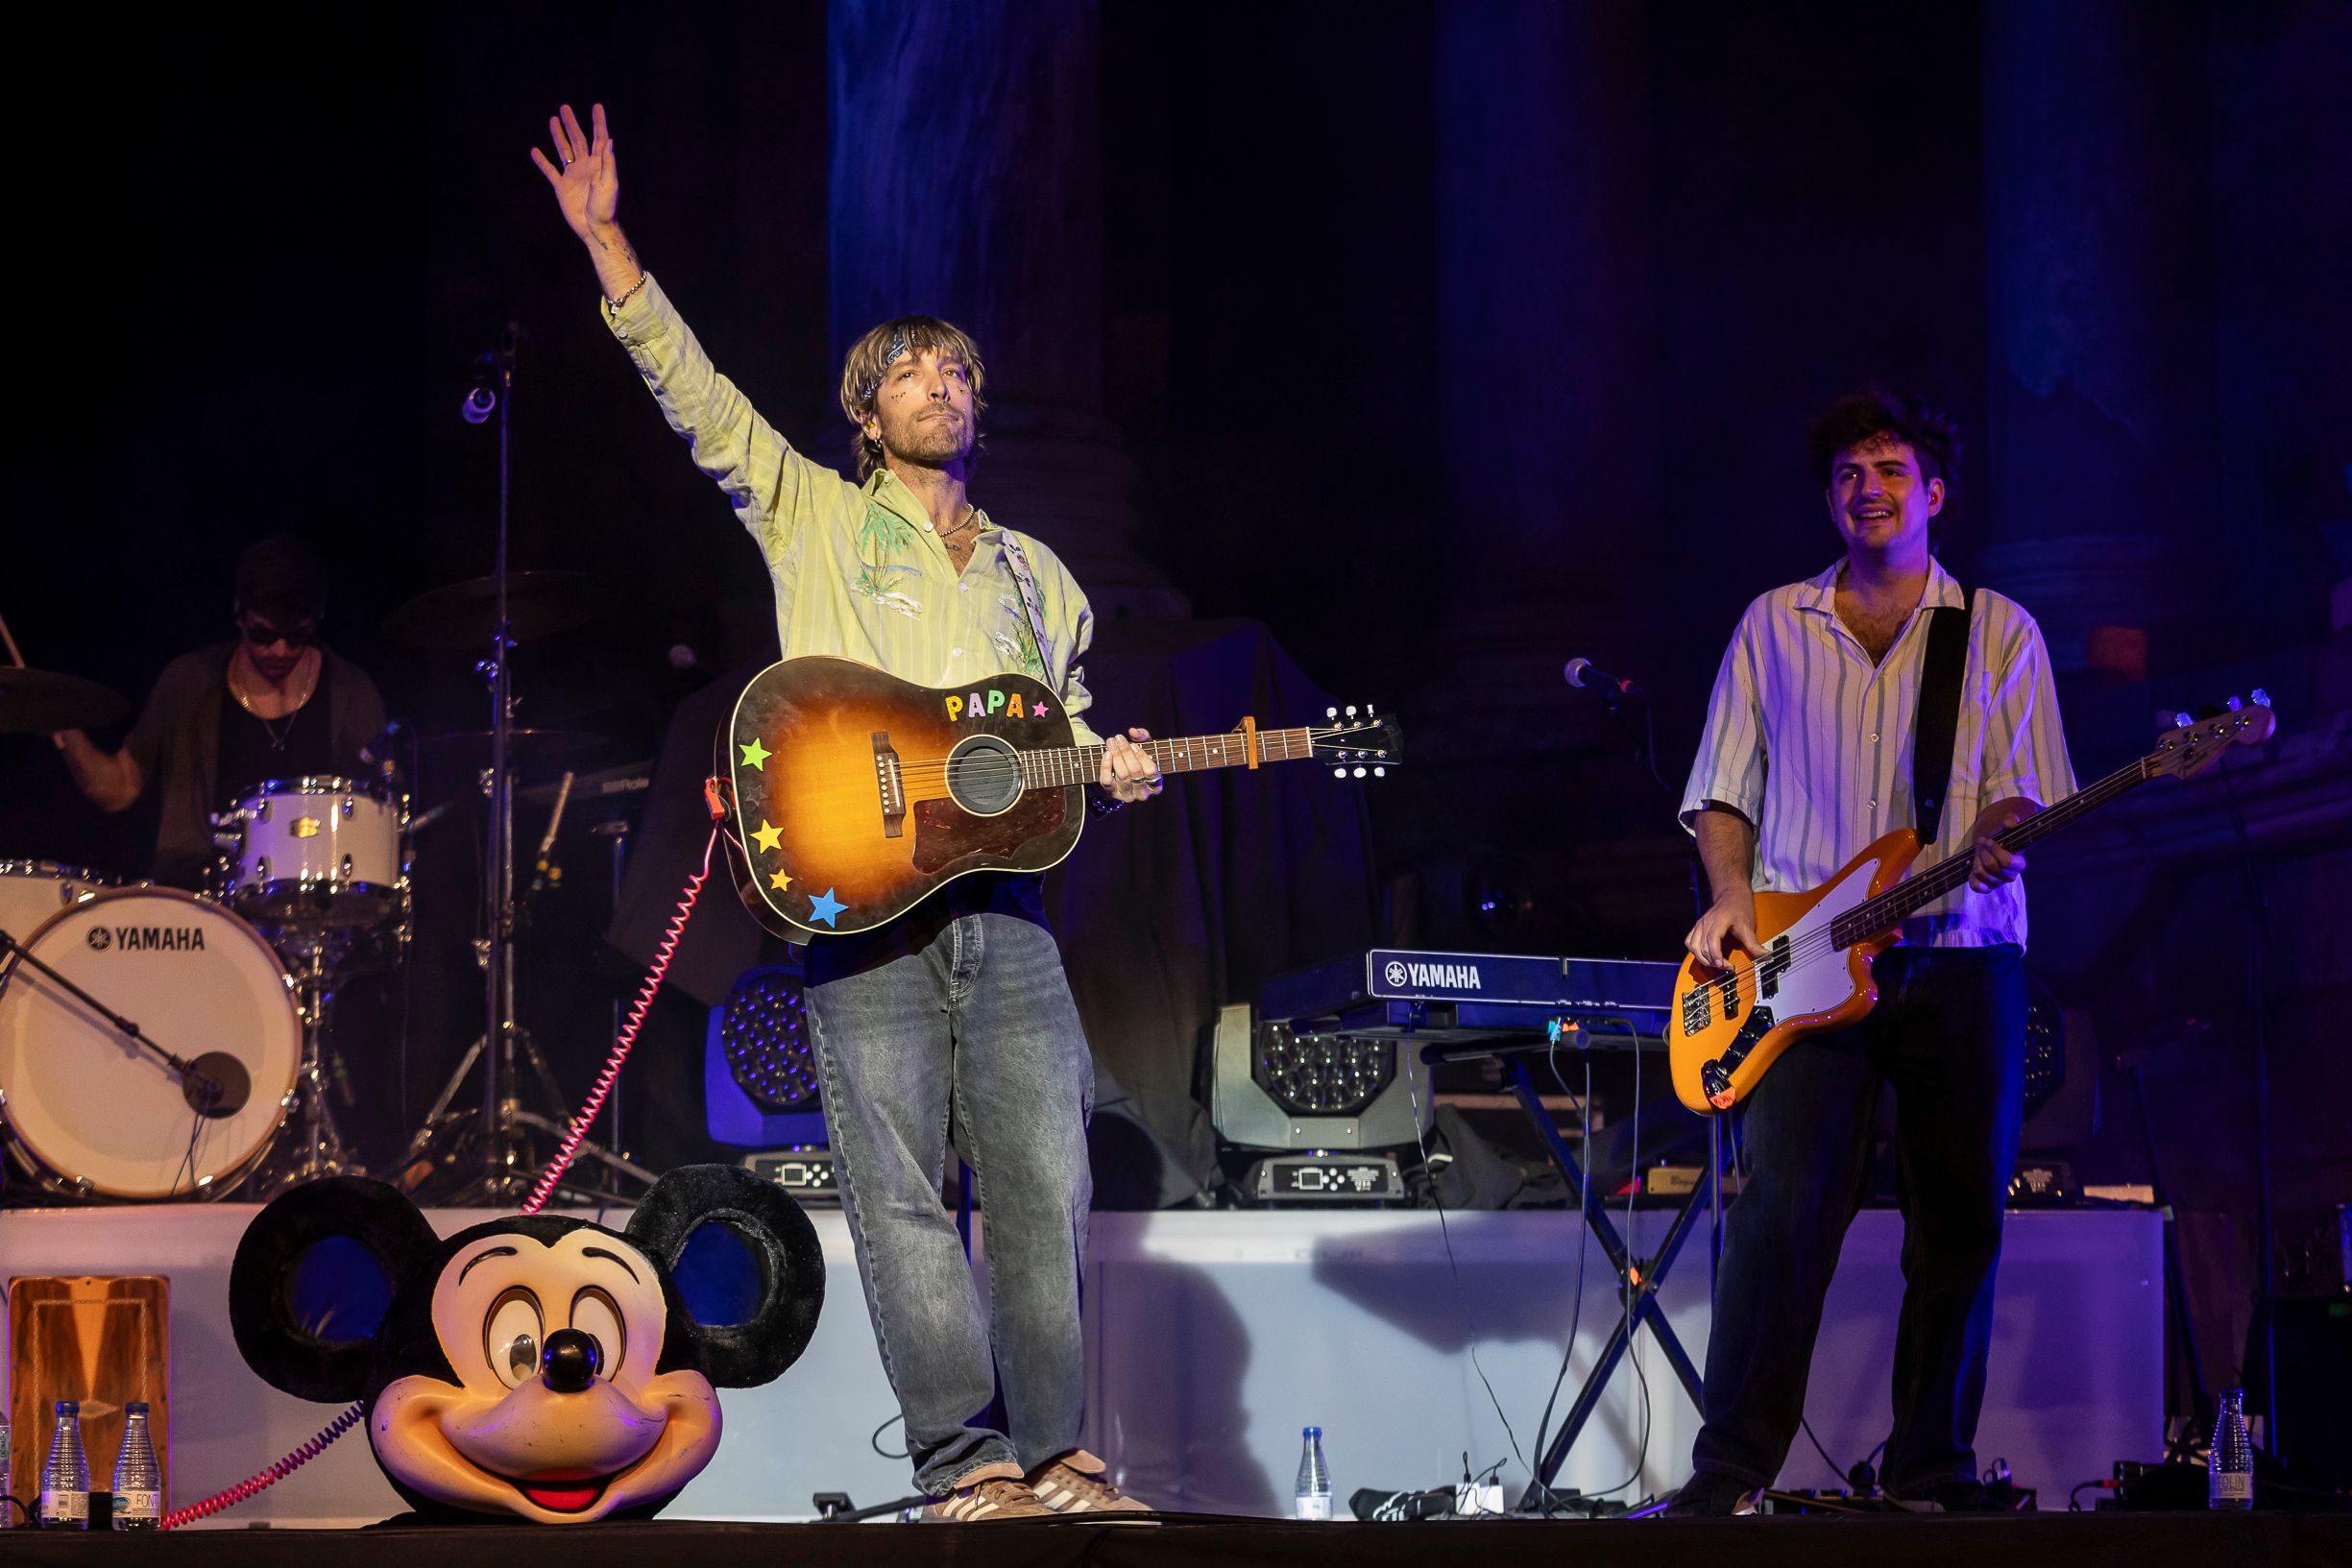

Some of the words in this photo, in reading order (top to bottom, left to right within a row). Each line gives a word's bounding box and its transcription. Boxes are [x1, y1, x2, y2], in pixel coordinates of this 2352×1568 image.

[944, 689, 1025, 722] PAPA
[115, 927, 206, 952] YAMAHA
[1407, 962, 1482, 990] YAMAHA
